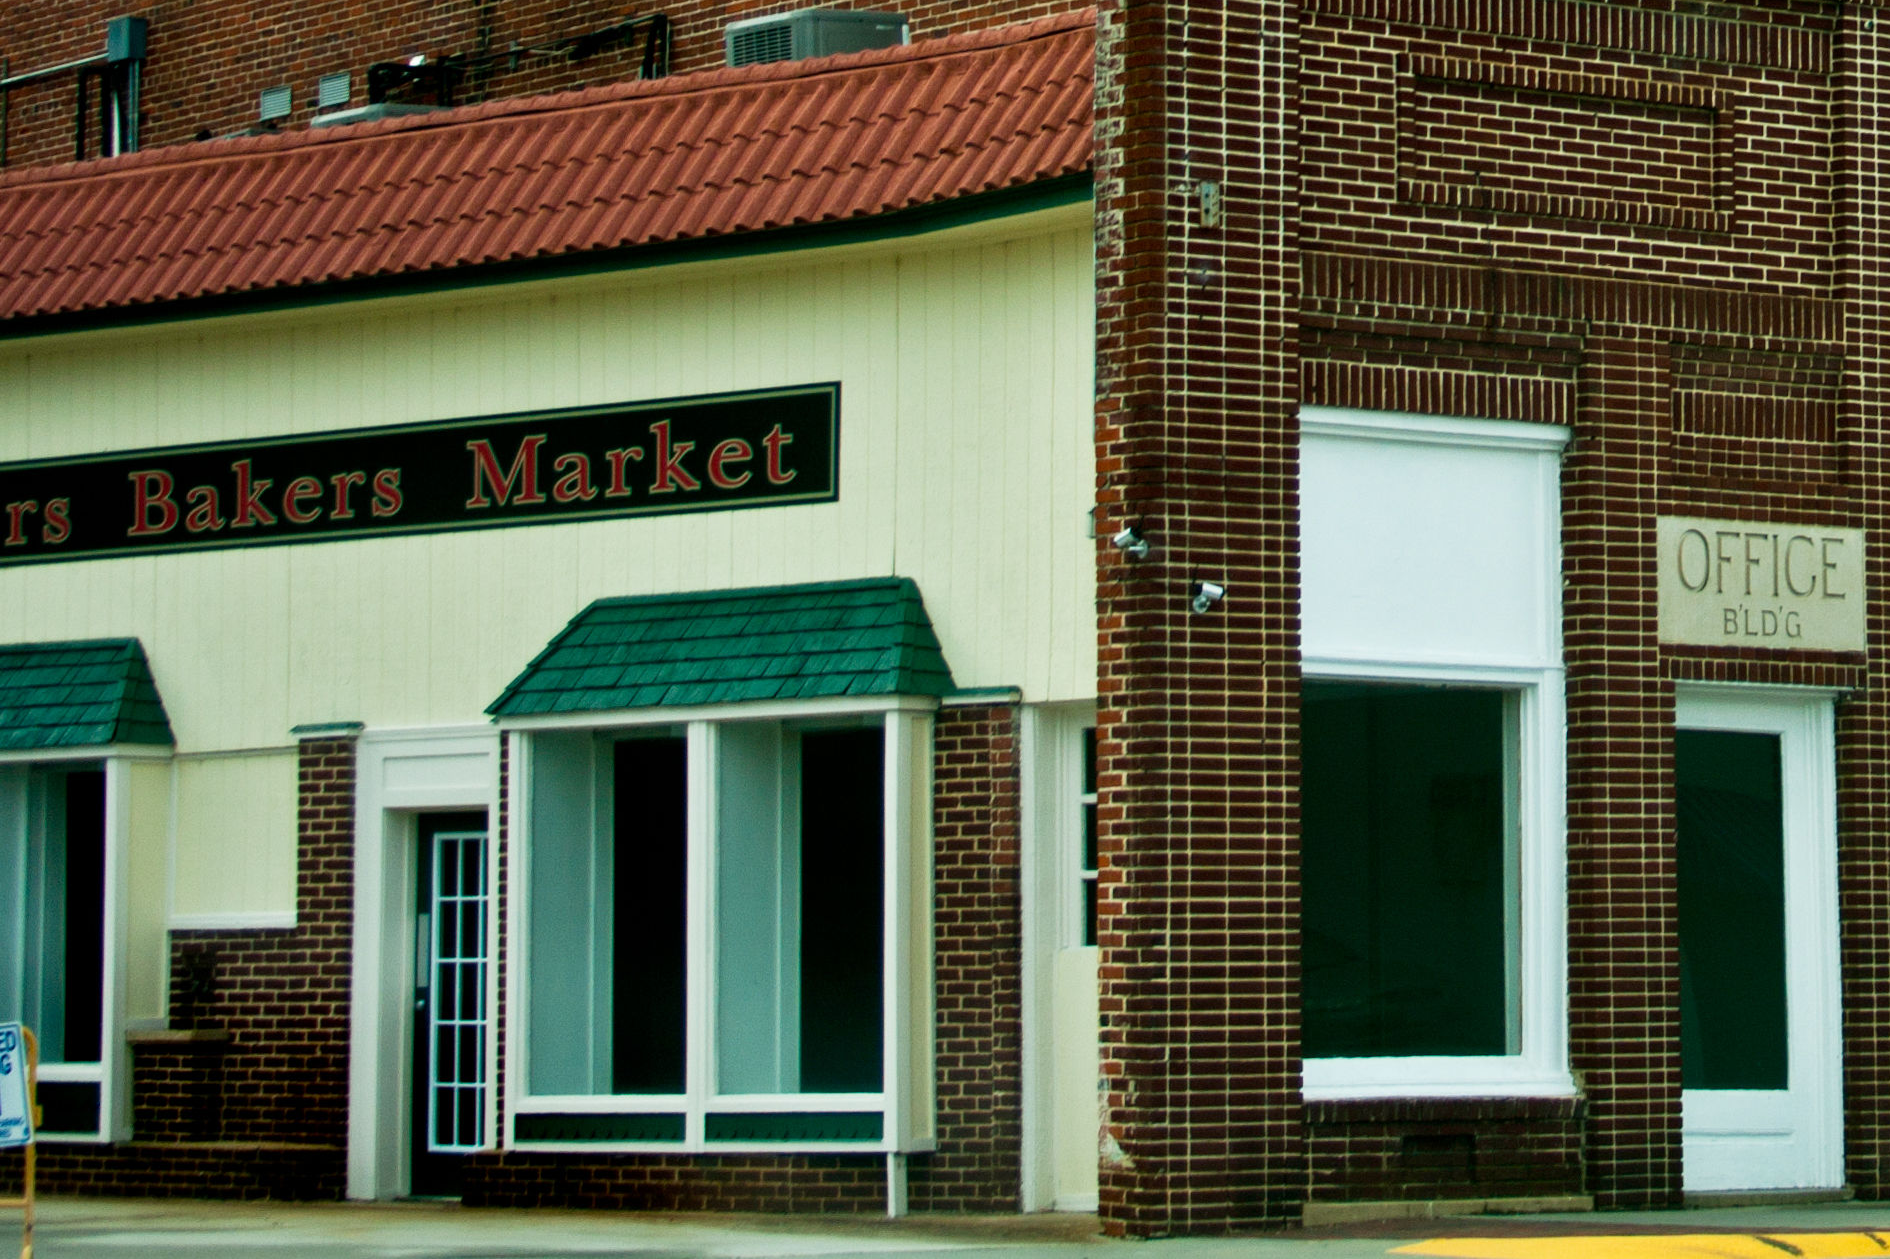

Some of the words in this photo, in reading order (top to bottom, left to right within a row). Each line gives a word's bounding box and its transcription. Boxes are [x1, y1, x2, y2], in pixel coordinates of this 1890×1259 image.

[127, 458, 403, 537] Bakers
[465, 419, 798, 509] Market
[1678, 528, 1846, 600] OFFICE
